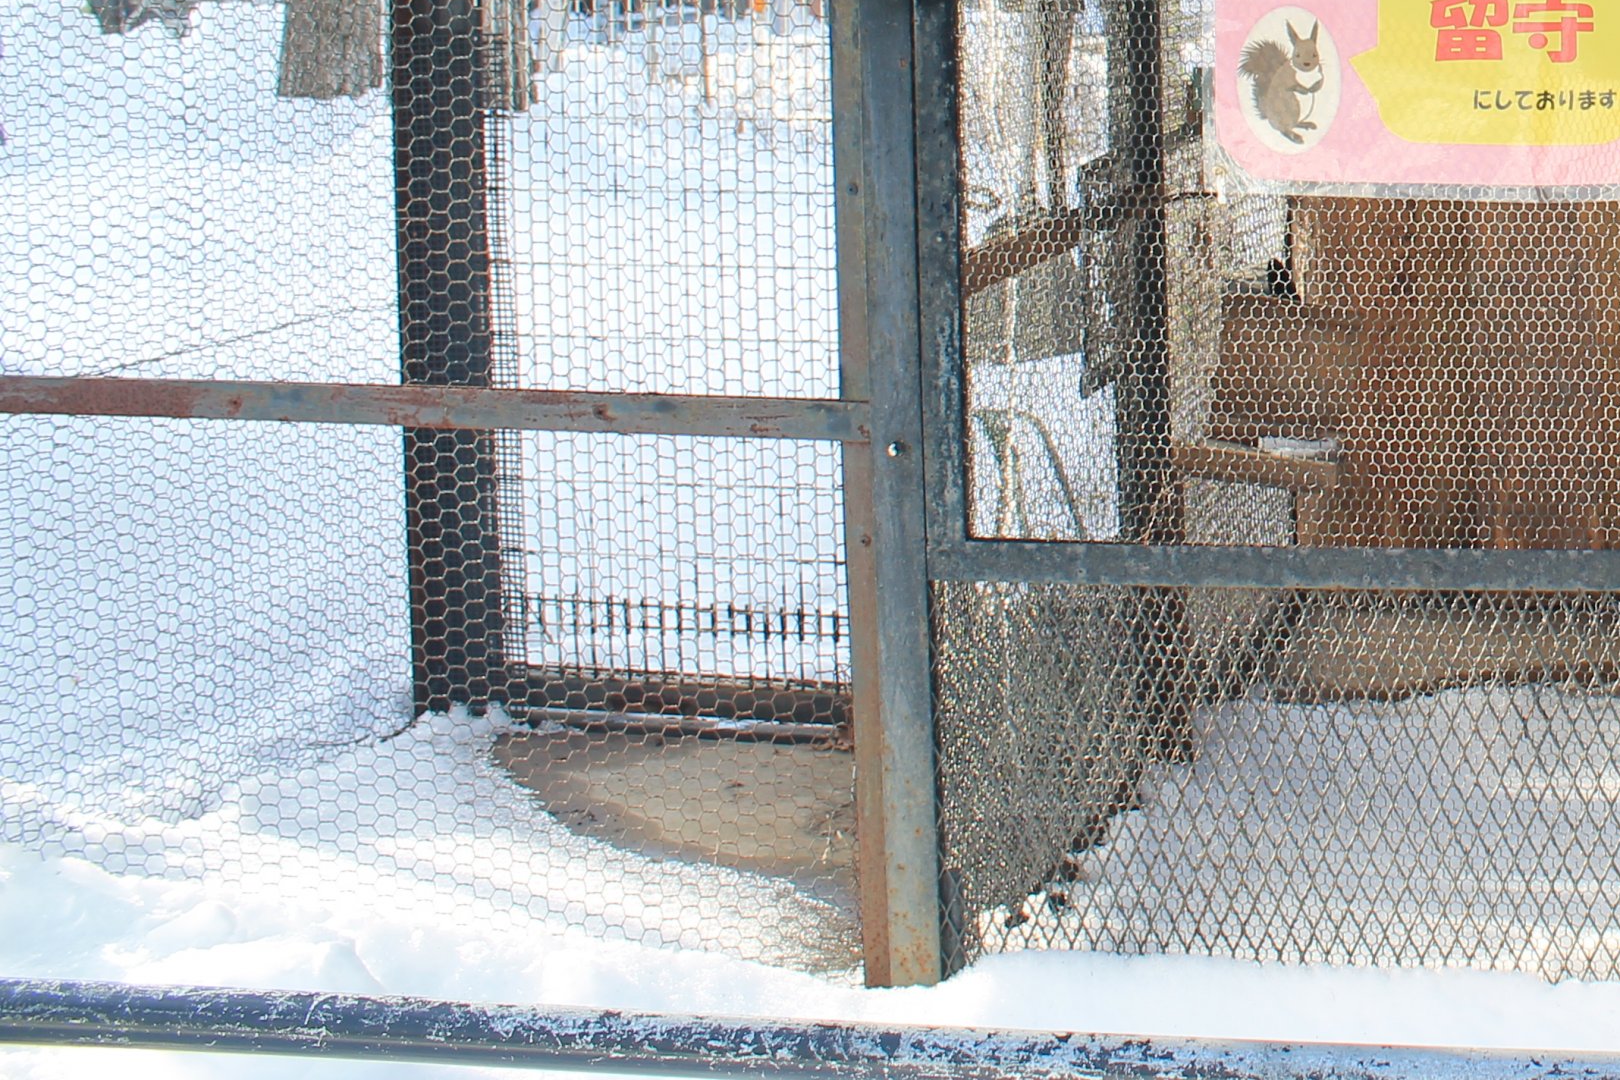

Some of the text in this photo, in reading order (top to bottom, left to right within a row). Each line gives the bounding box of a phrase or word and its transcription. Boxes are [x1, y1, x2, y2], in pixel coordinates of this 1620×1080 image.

[1473, 89, 1617, 111] にしております
